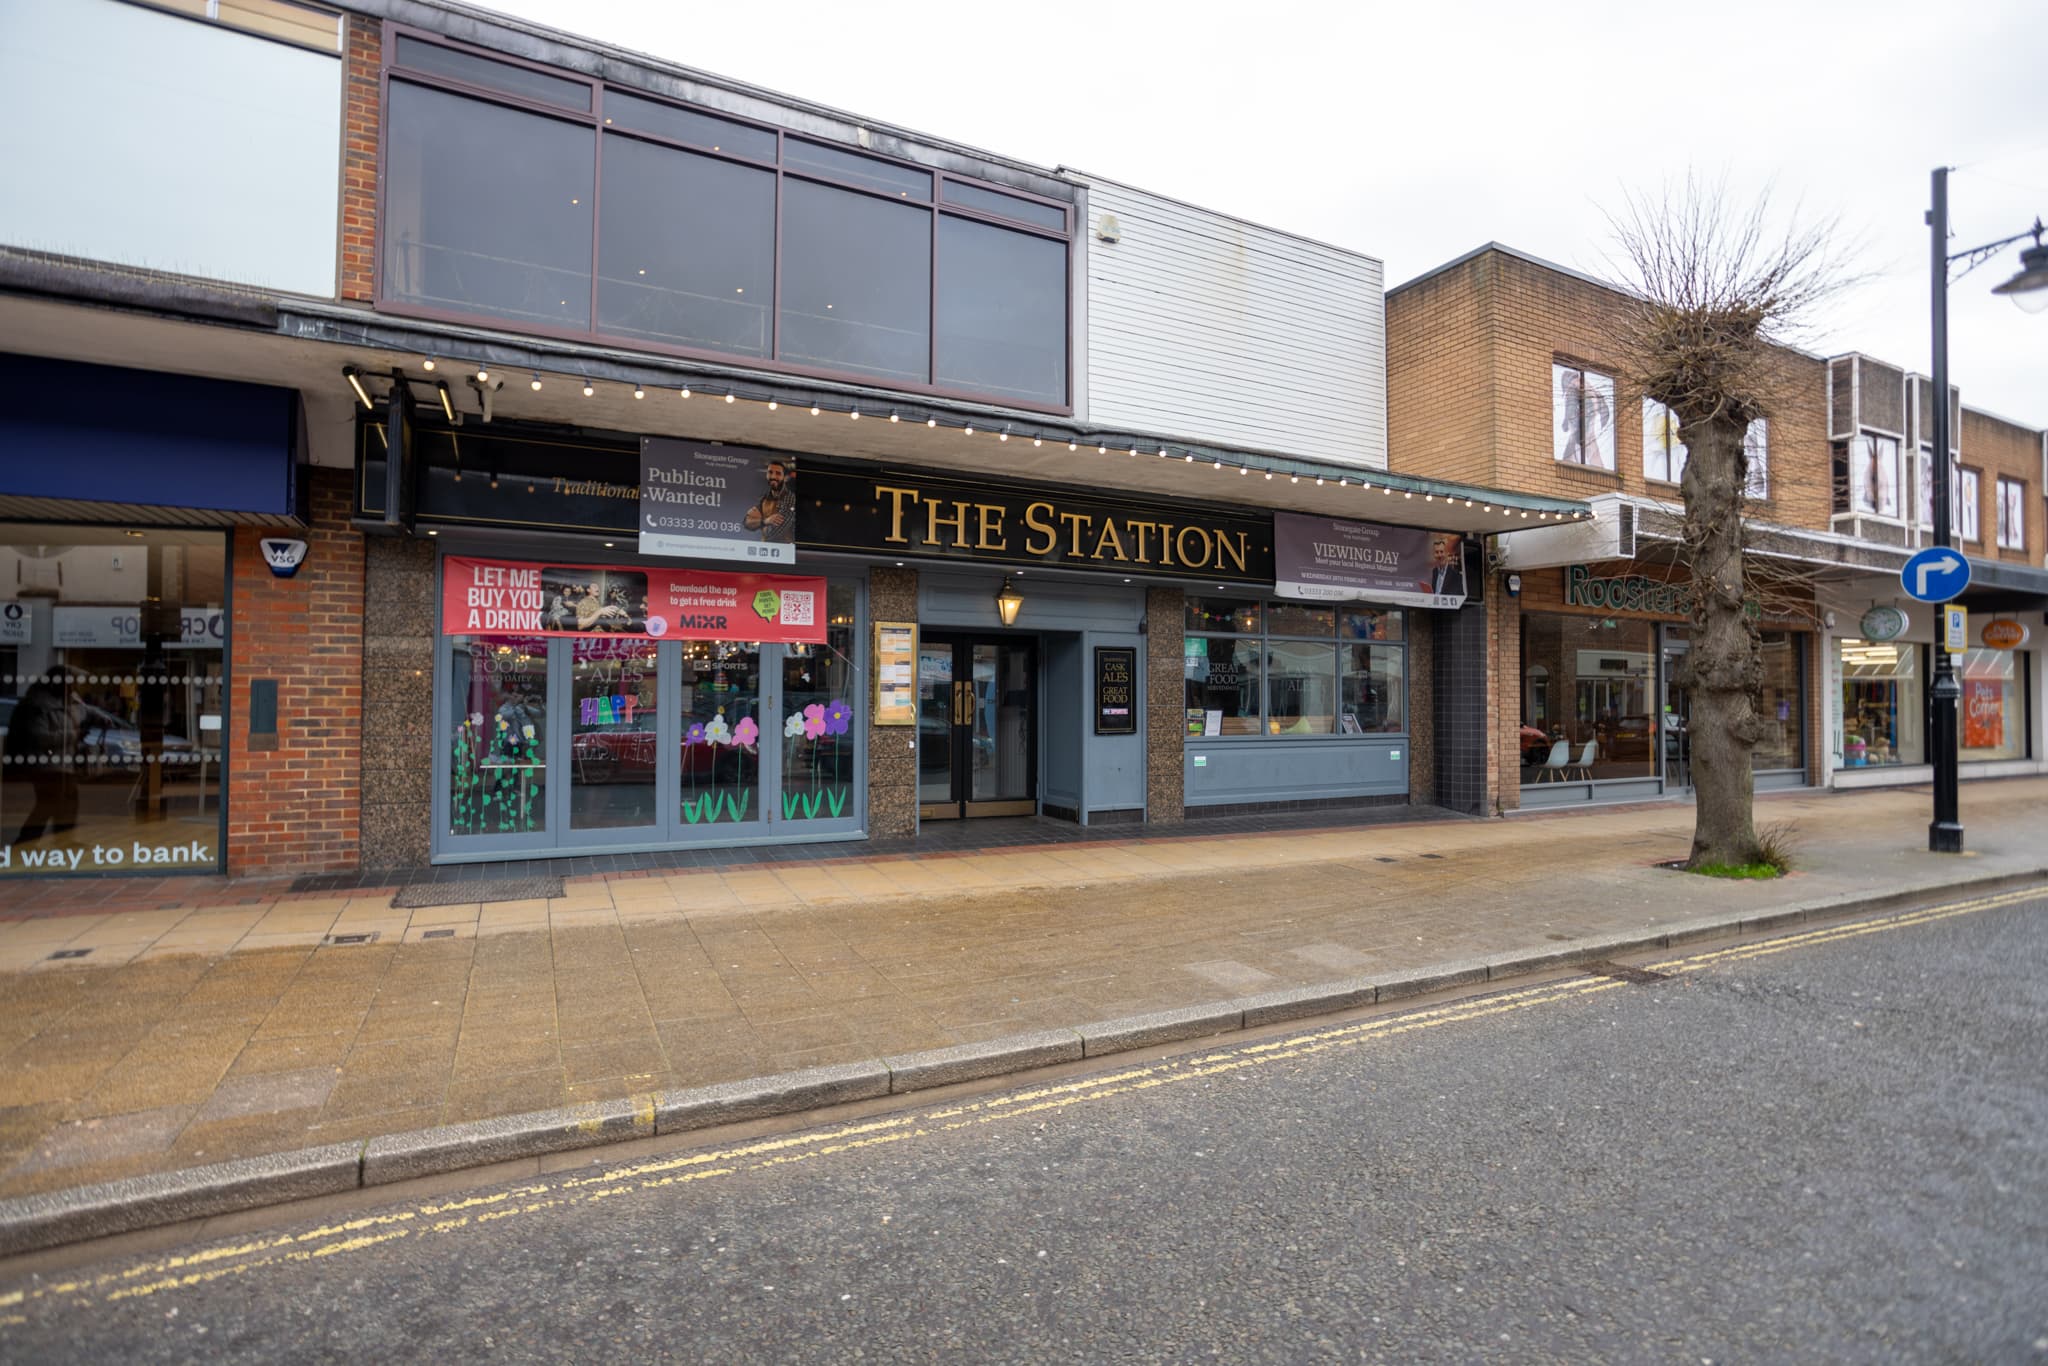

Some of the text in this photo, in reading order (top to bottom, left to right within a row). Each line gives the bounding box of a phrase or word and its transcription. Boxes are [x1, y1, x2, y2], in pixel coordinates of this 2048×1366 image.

[648, 467, 727, 489] Publican
[552, 476, 640, 500] Traditional
[647, 487, 722, 508] Wanted!
[659, 516, 741, 533] 03333 200 036
[875, 485, 1249, 573] THE STATION
[271, 555, 295, 564] VSG
[1313, 542, 1400, 565] VIEWING DAY
[474, 567, 539, 588] LET ME
[670, 583, 737, 596] Download the app
[1566, 564, 1694, 615] Roosters
[468, 587, 544, 609] BUY YOU
[670, 597, 678, 605] to
[679, 598, 692, 607] get
[699, 598, 714, 606] free
[715, 599, 737, 608] drink
[467, 609, 544, 630] A DRINK
[587, 647, 645, 662] CASK
[473, 658, 528, 673] FOOD
[711, 662, 748, 671] SPORTS
[1105, 663, 1126, 671] CASK
[1209, 663, 1239, 673] GREAT
[589, 667, 644, 683] ALES
[1103, 672, 1128, 682] ALES
[1209, 674, 1239, 685] FOOD
[1103, 687, 1128, 695] GREAT
[1975, 682, 1994, 699] Pets
[1103, 695, 1128, 704] FOOD
[1969, 698, 2000, 717] Corner
[20, 848, 85, 870] way
[92, 844, 124, 865] to
[133, 841, 215, 864] bank.
